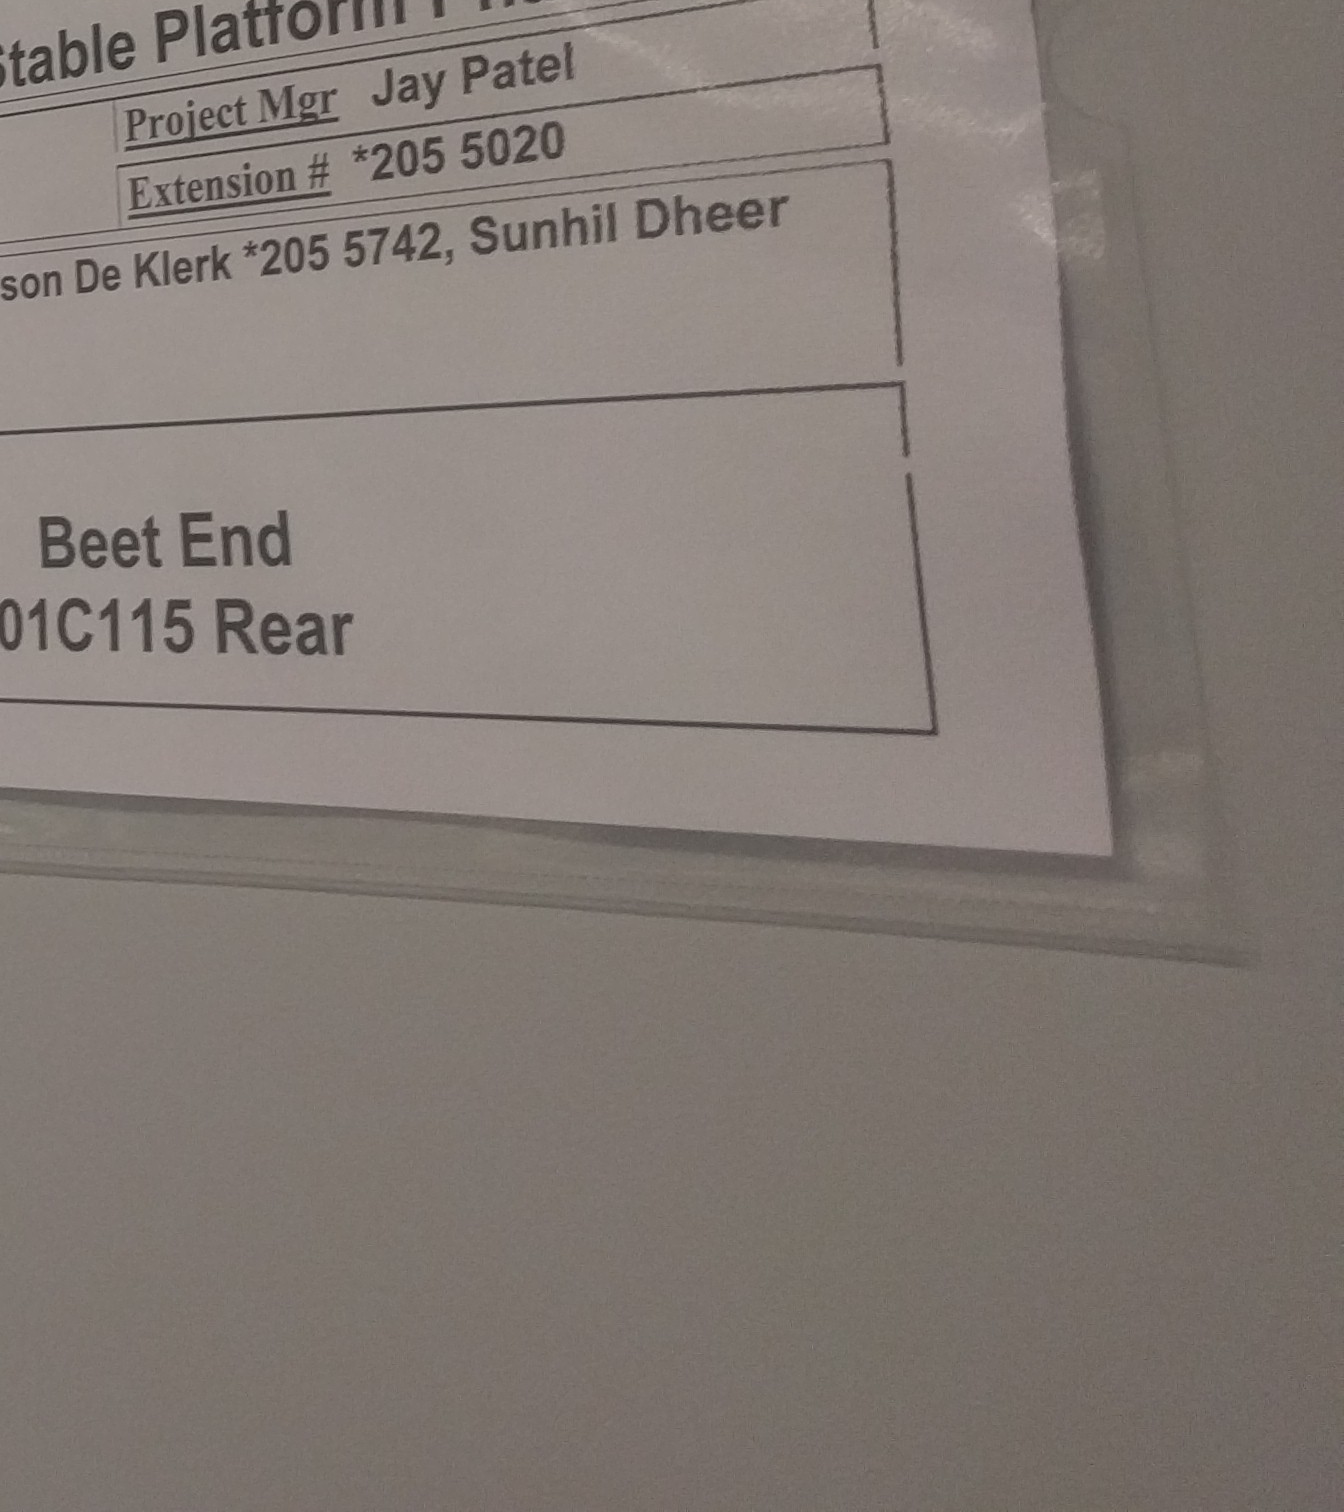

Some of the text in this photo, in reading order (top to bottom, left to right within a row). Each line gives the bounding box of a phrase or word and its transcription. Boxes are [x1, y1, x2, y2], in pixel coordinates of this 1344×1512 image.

[124, 42, 575, 144] Project Mgr Jay Patel
[126, 164, 298, 212] Extension
[307, 152, 331, 190] #
[460, 120, 566, 171] 5020
[74, 258, 122, 295] De
[133, 244, 233, 288] Klerk
[343, 220, 455, 269] 5742,
[469, 202, 617, 256] Sunhil
[635, 193, 789, 239] Dheer
[38, 510, 293, 569] Beet End
[215, 599, 354, 656] Rear
